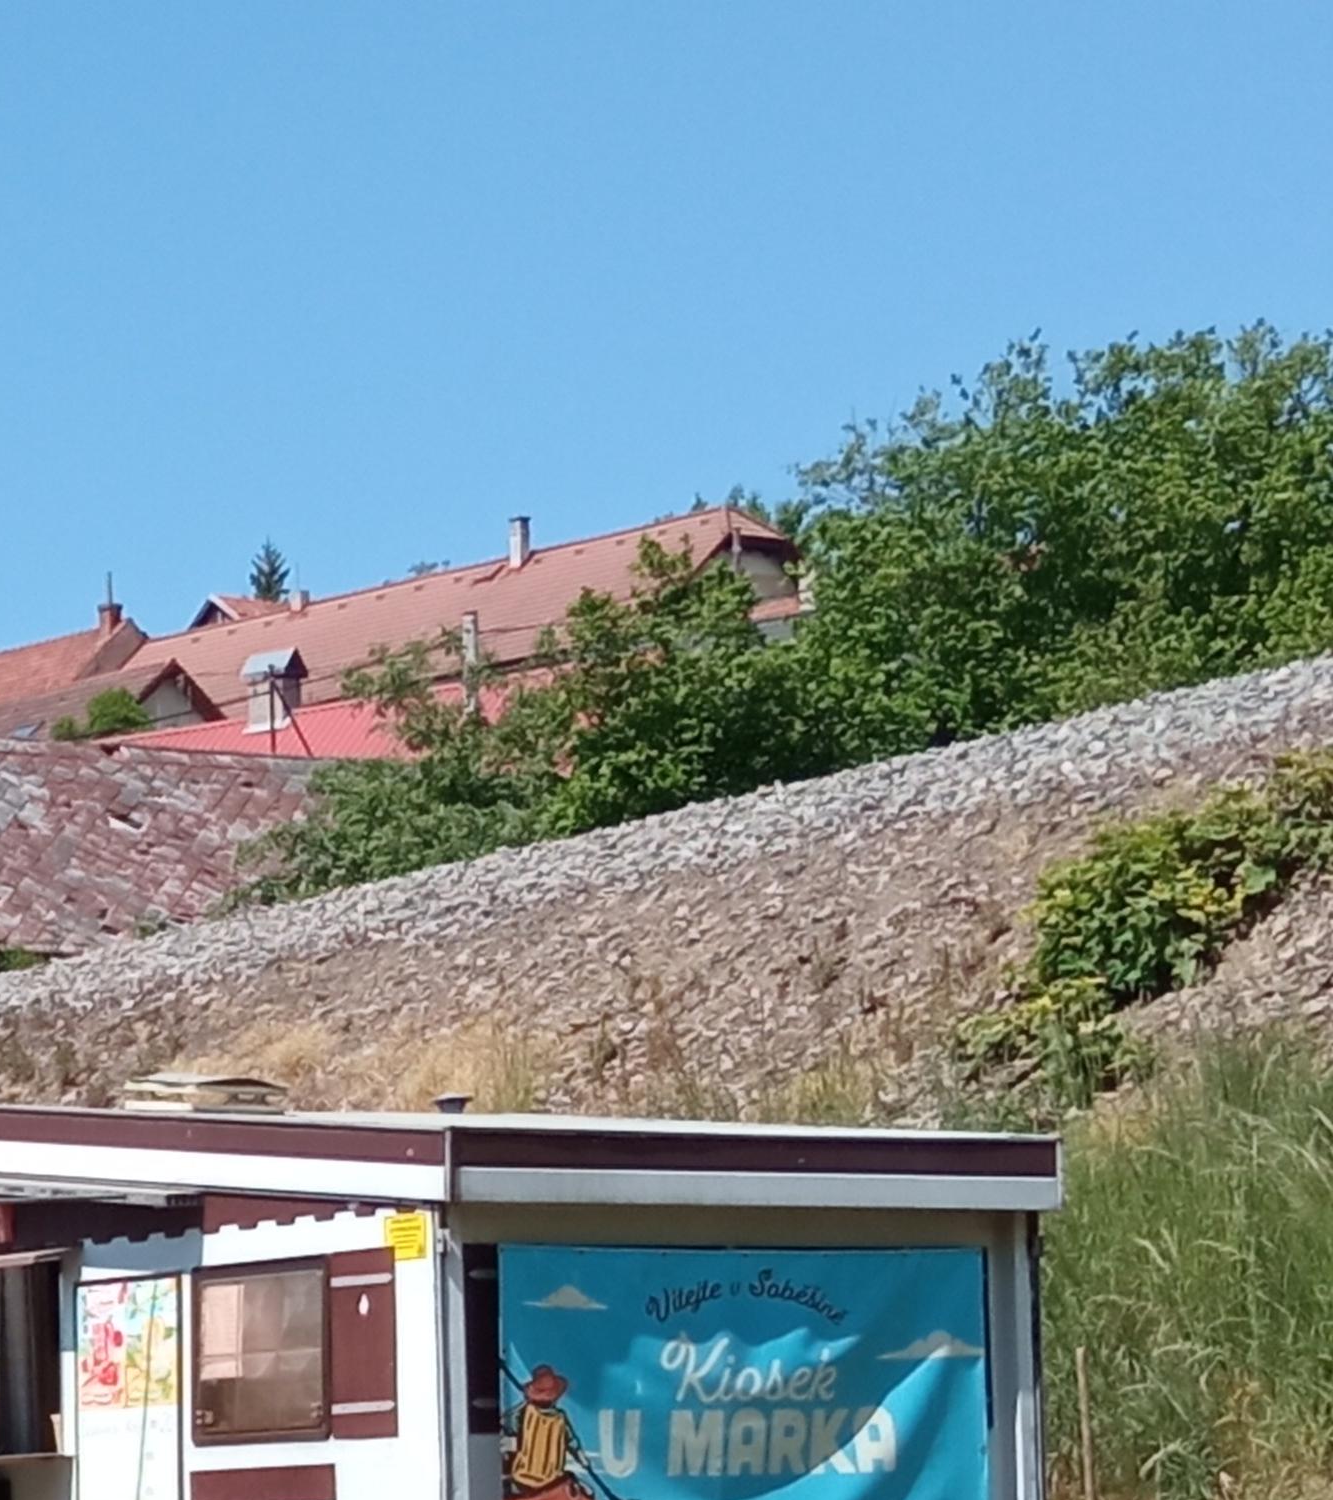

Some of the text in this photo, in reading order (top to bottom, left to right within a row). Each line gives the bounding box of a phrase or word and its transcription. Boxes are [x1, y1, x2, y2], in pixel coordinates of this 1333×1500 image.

[660, 1335, 836, 1402] Kiosek
[598, 1406, 898, 1479] U MARKA
